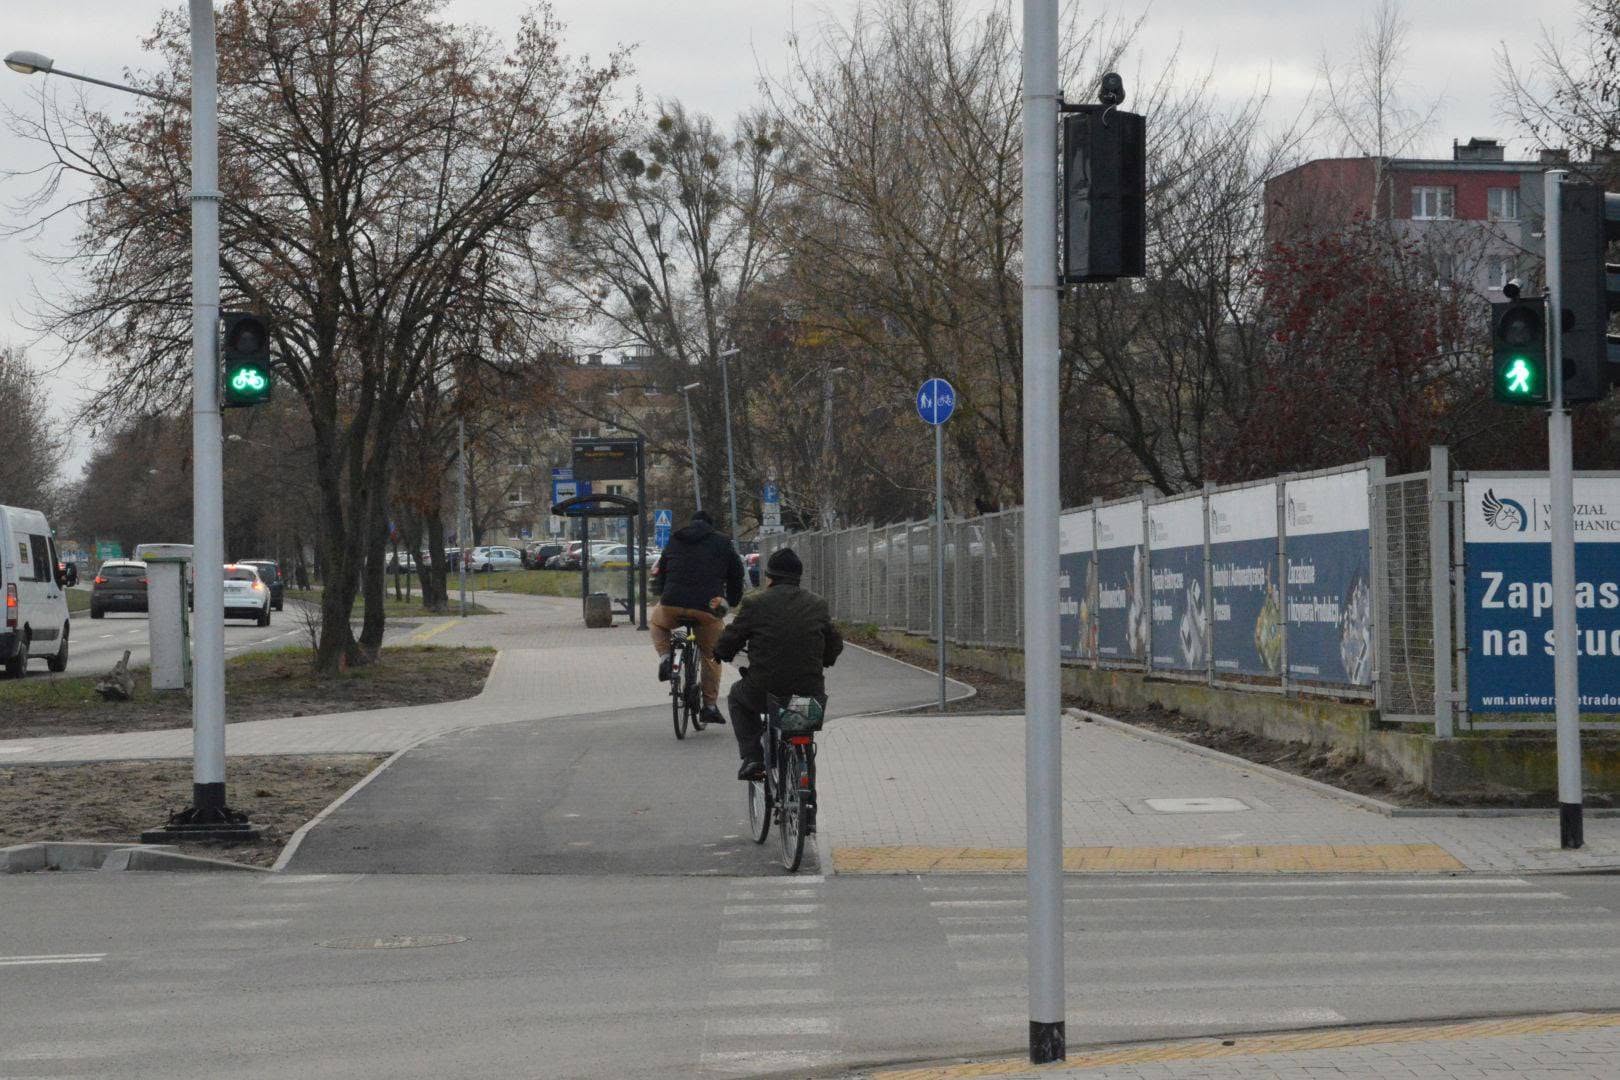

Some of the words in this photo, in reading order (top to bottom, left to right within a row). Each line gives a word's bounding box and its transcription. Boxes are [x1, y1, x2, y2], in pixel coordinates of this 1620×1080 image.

[1543, 504, 1607, 515] WZIAŁ
[1544, 520, 1620, 531] MHANIC
[1481, 571, 1620, 618] Zapas
[1482, 629, 1528, 656] na
[1482, 693, 1620, 706] wm.uniwertrado
